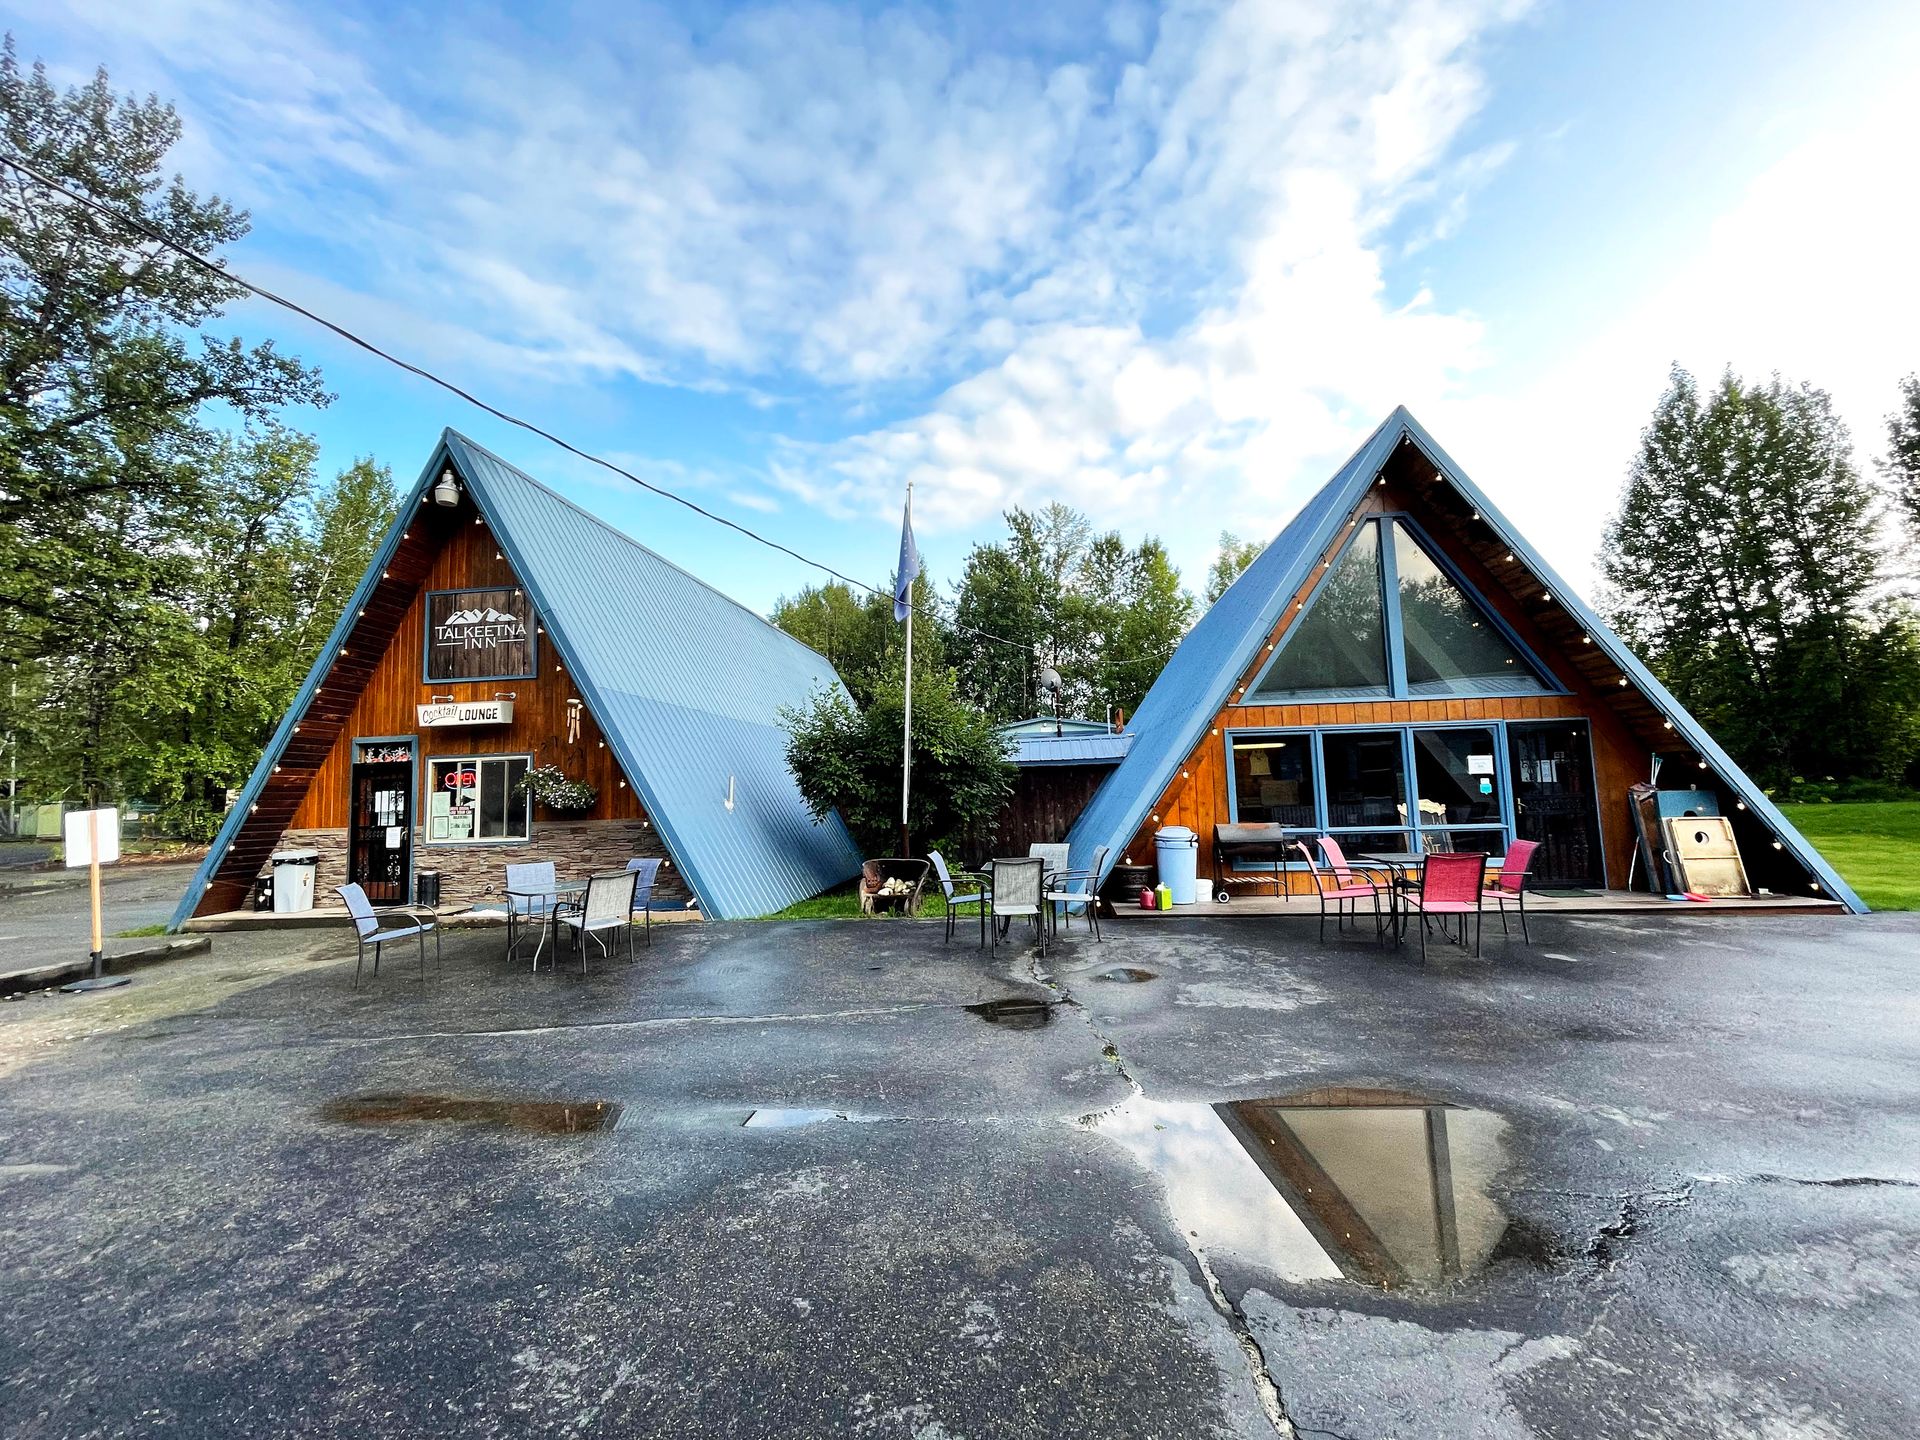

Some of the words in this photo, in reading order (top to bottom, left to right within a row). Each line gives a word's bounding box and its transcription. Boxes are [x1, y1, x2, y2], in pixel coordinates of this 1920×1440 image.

[435, 623, 527, 640] TALKEETNA
[464, 636, 497, 650] INN
[422, 705, 459, 724] Cocktail
[458, 707, 498, 721] LOUNGE
